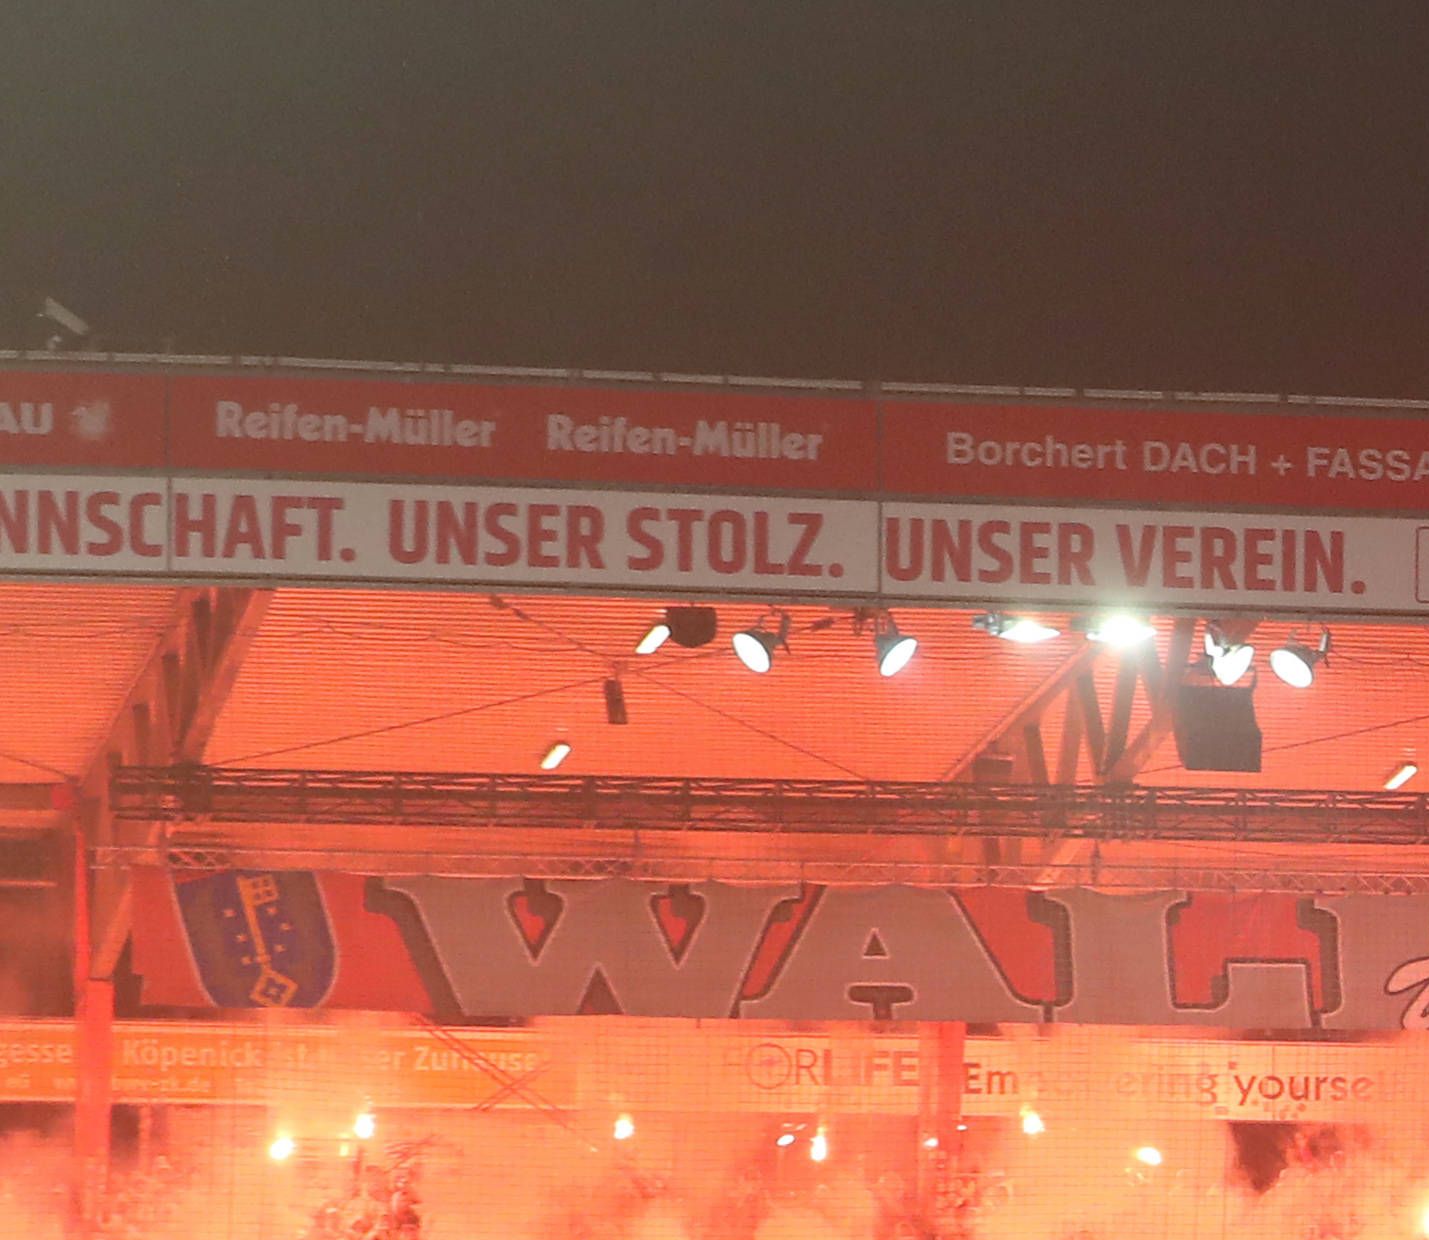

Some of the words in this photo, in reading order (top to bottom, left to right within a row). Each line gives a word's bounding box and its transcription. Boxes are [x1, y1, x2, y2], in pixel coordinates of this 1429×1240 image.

[216, 401, 497, 449] Reifen-Müller
[547, 414, 823, 462] Reifen-Müller
[945, 431, 1127, 472] Borchert
[1143, 441, 1257, 477] DACH
[1270, 456, 1292, 478] +
[389, 499, 605, 570] UNSER
[626, 506, 844, 577] STOLZ.
[884, 517, 1096, 586] UNSER
[1116, 524, 1367, 595] VEREIN.
[123, 1039, 264, 1071] Köpenick
